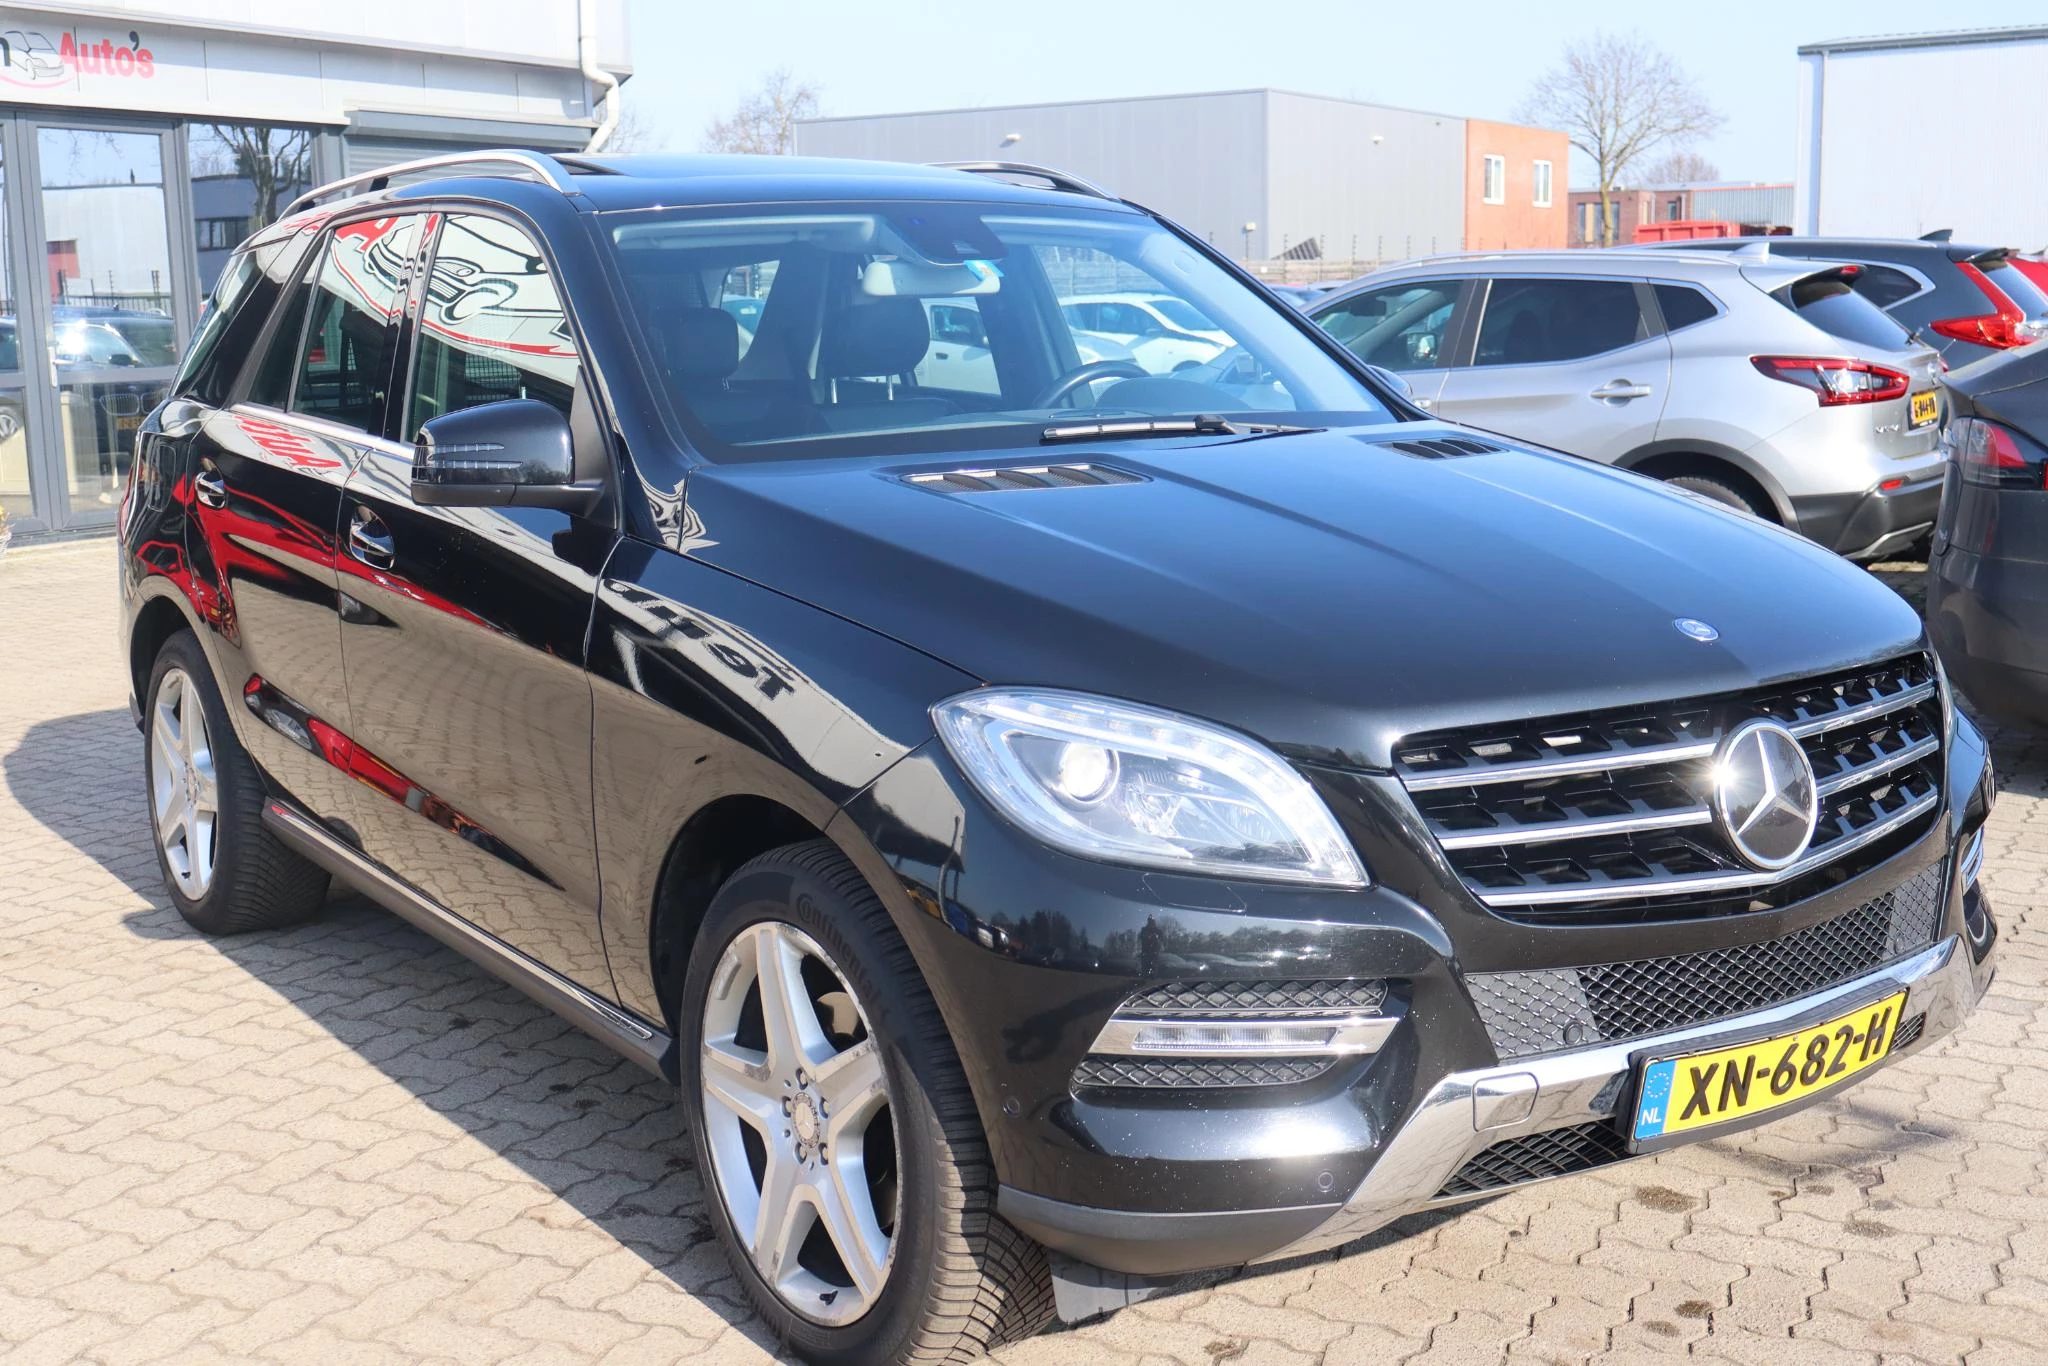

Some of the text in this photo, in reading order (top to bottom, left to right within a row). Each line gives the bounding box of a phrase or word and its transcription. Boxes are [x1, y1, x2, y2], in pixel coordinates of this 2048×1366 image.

[59, 31, 155, 79] Auto's
[1679, 1006, 1893, 1121] XN-682-H
[1640, 1107, 1662, 1126] NL
